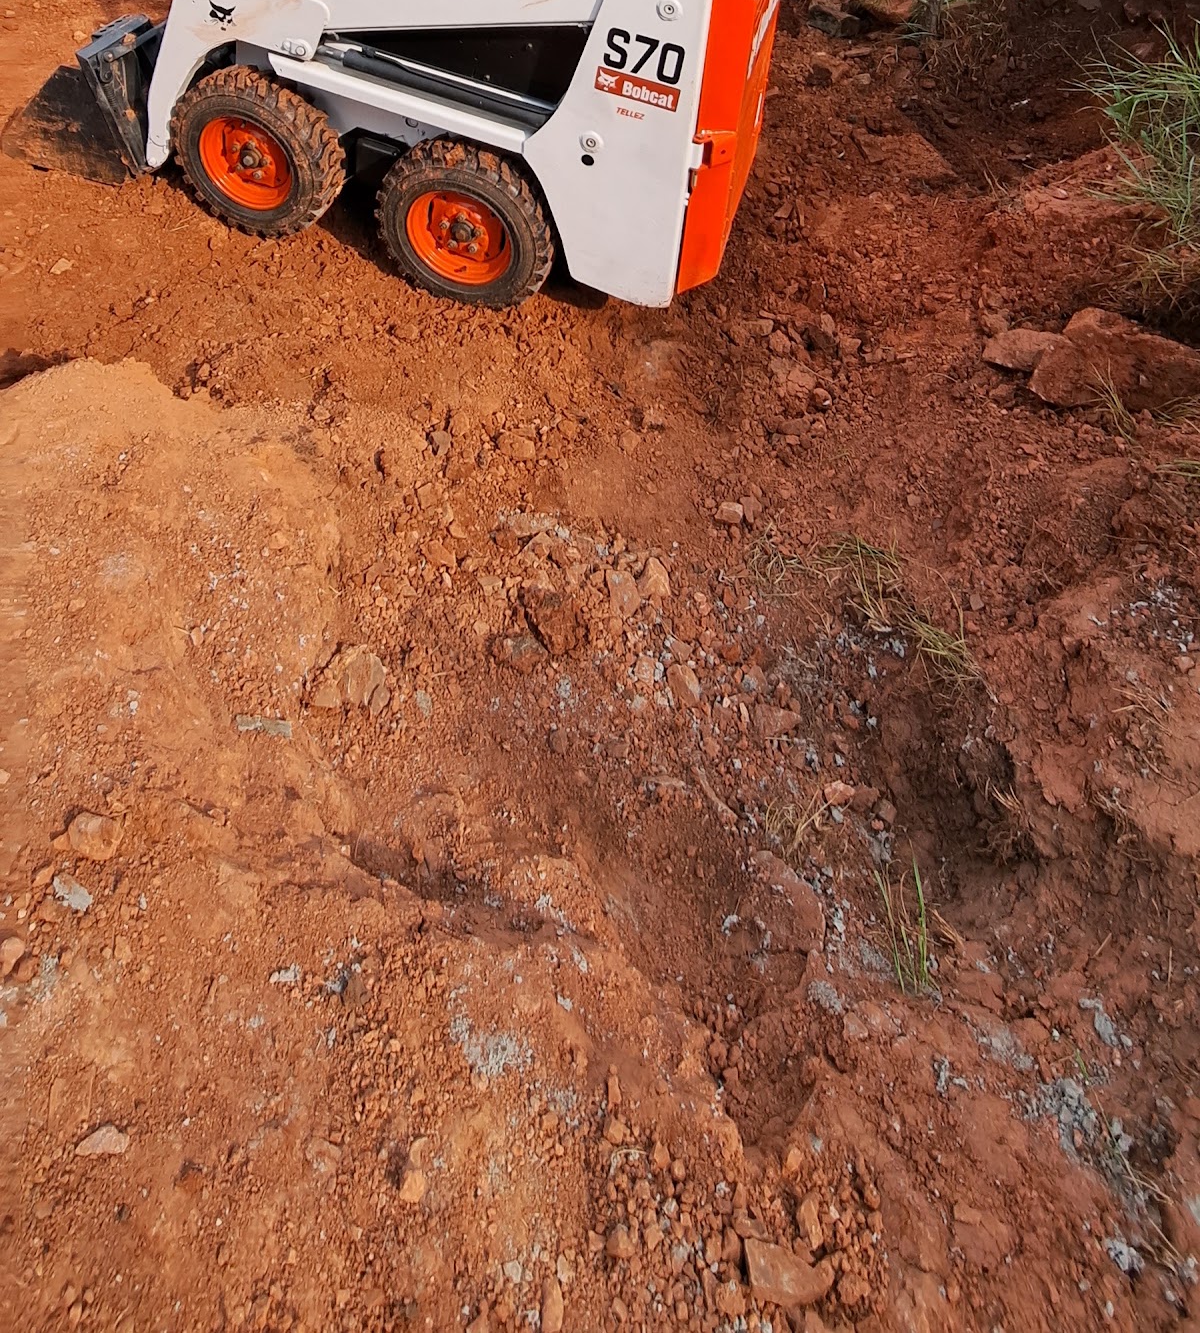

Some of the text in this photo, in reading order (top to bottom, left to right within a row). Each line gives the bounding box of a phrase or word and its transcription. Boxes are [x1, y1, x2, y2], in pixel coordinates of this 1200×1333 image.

[603, 27, 685, 85] S70
[622, 80, 674, 109] Bobcat
[616, 106, 645, 120] TELLEZ
